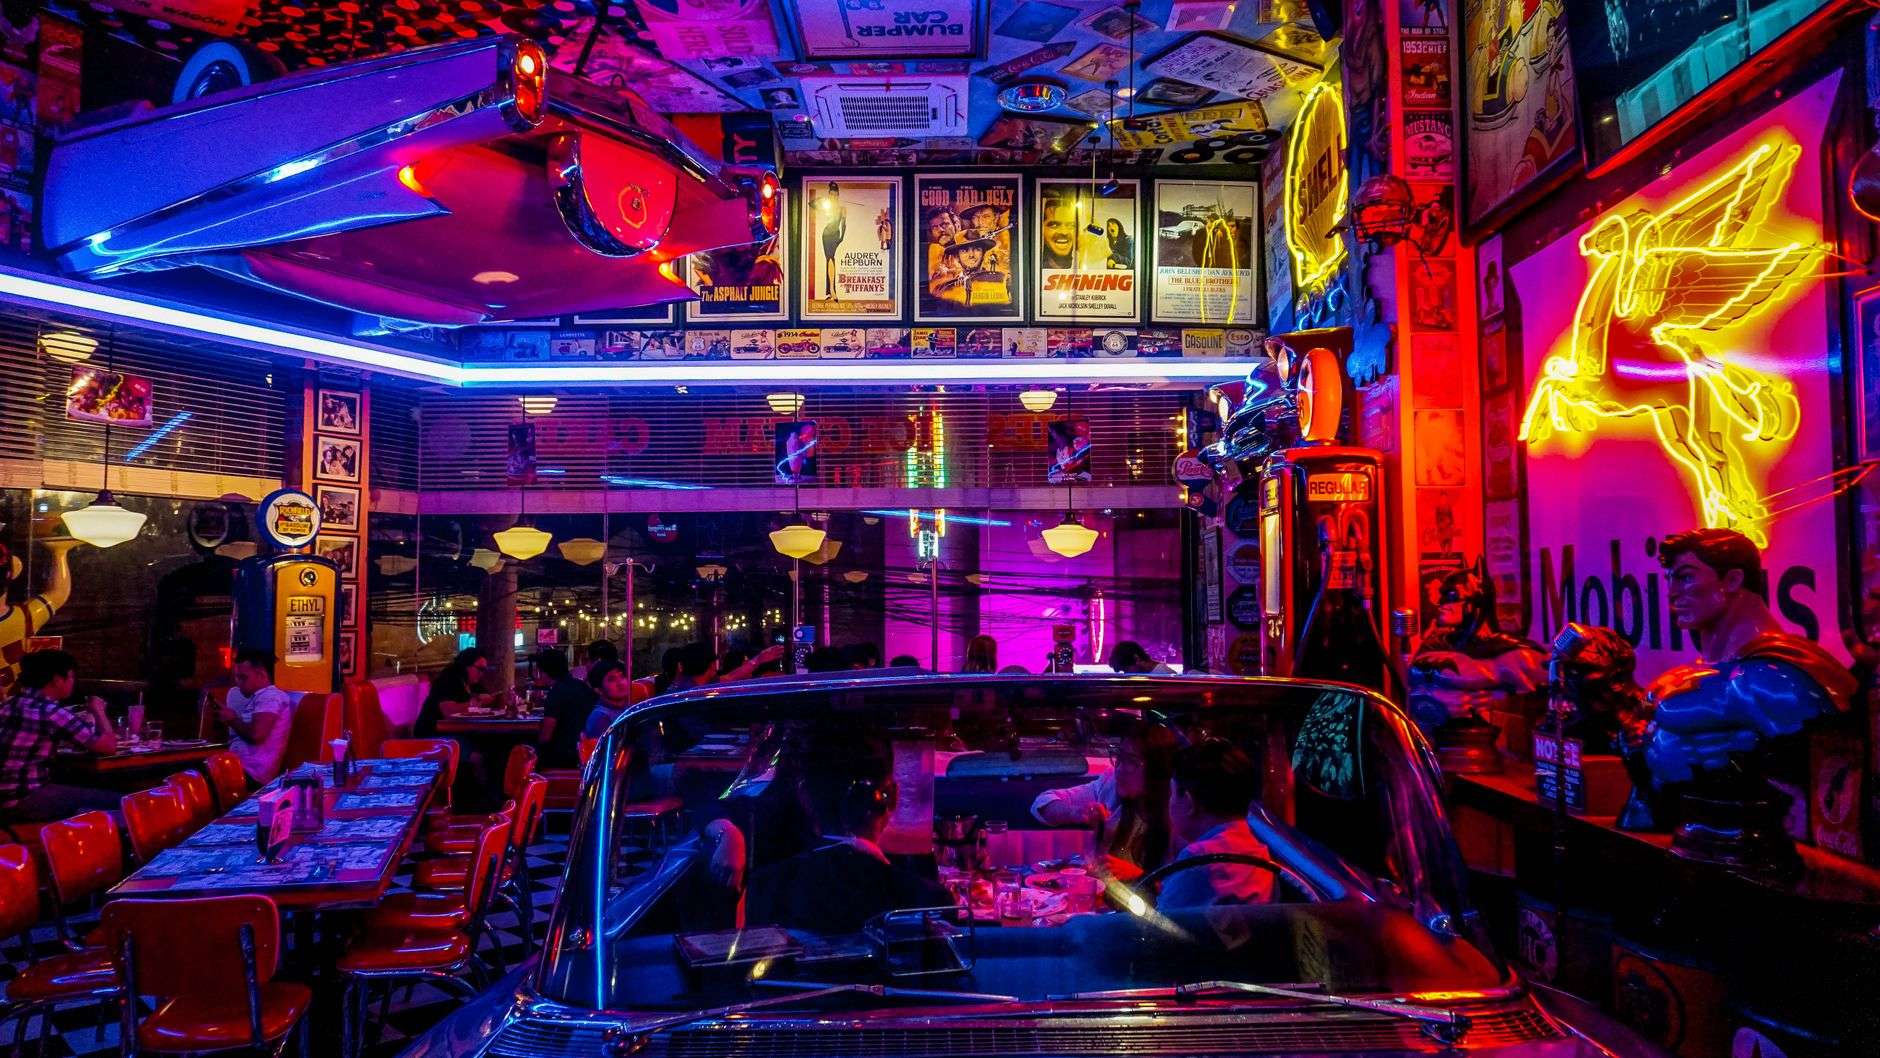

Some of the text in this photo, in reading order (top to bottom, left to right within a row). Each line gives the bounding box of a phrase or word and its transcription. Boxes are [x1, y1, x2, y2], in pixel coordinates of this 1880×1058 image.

[163, 6, 227, 27] WAGON
[894, 10, 949, 24] CAR
[857, 24, 964, 37] BUMPER
[1403, 41, 1421, 53] 1953
[1423, 45, 1447, 53] CHIEF
[1406, 120, 1452, 137] MUSTANG
[1299, 134, 1345, 226] SHELL
[922, 189, 950, 206] GOOD
[986, 189, 1015, 205] UGLY
[840, 259, 883, 267] HEPBURN
[838, 274, 886, 284] BREAKFAST
[701, 286, 779, 302] The ASPHALT JUNGLE
[1185, 334, 1223, 349] GASOLINE
[1309, 481, 1368, 494] REGULAR
[290, 598, 321, 612] ETHYL
